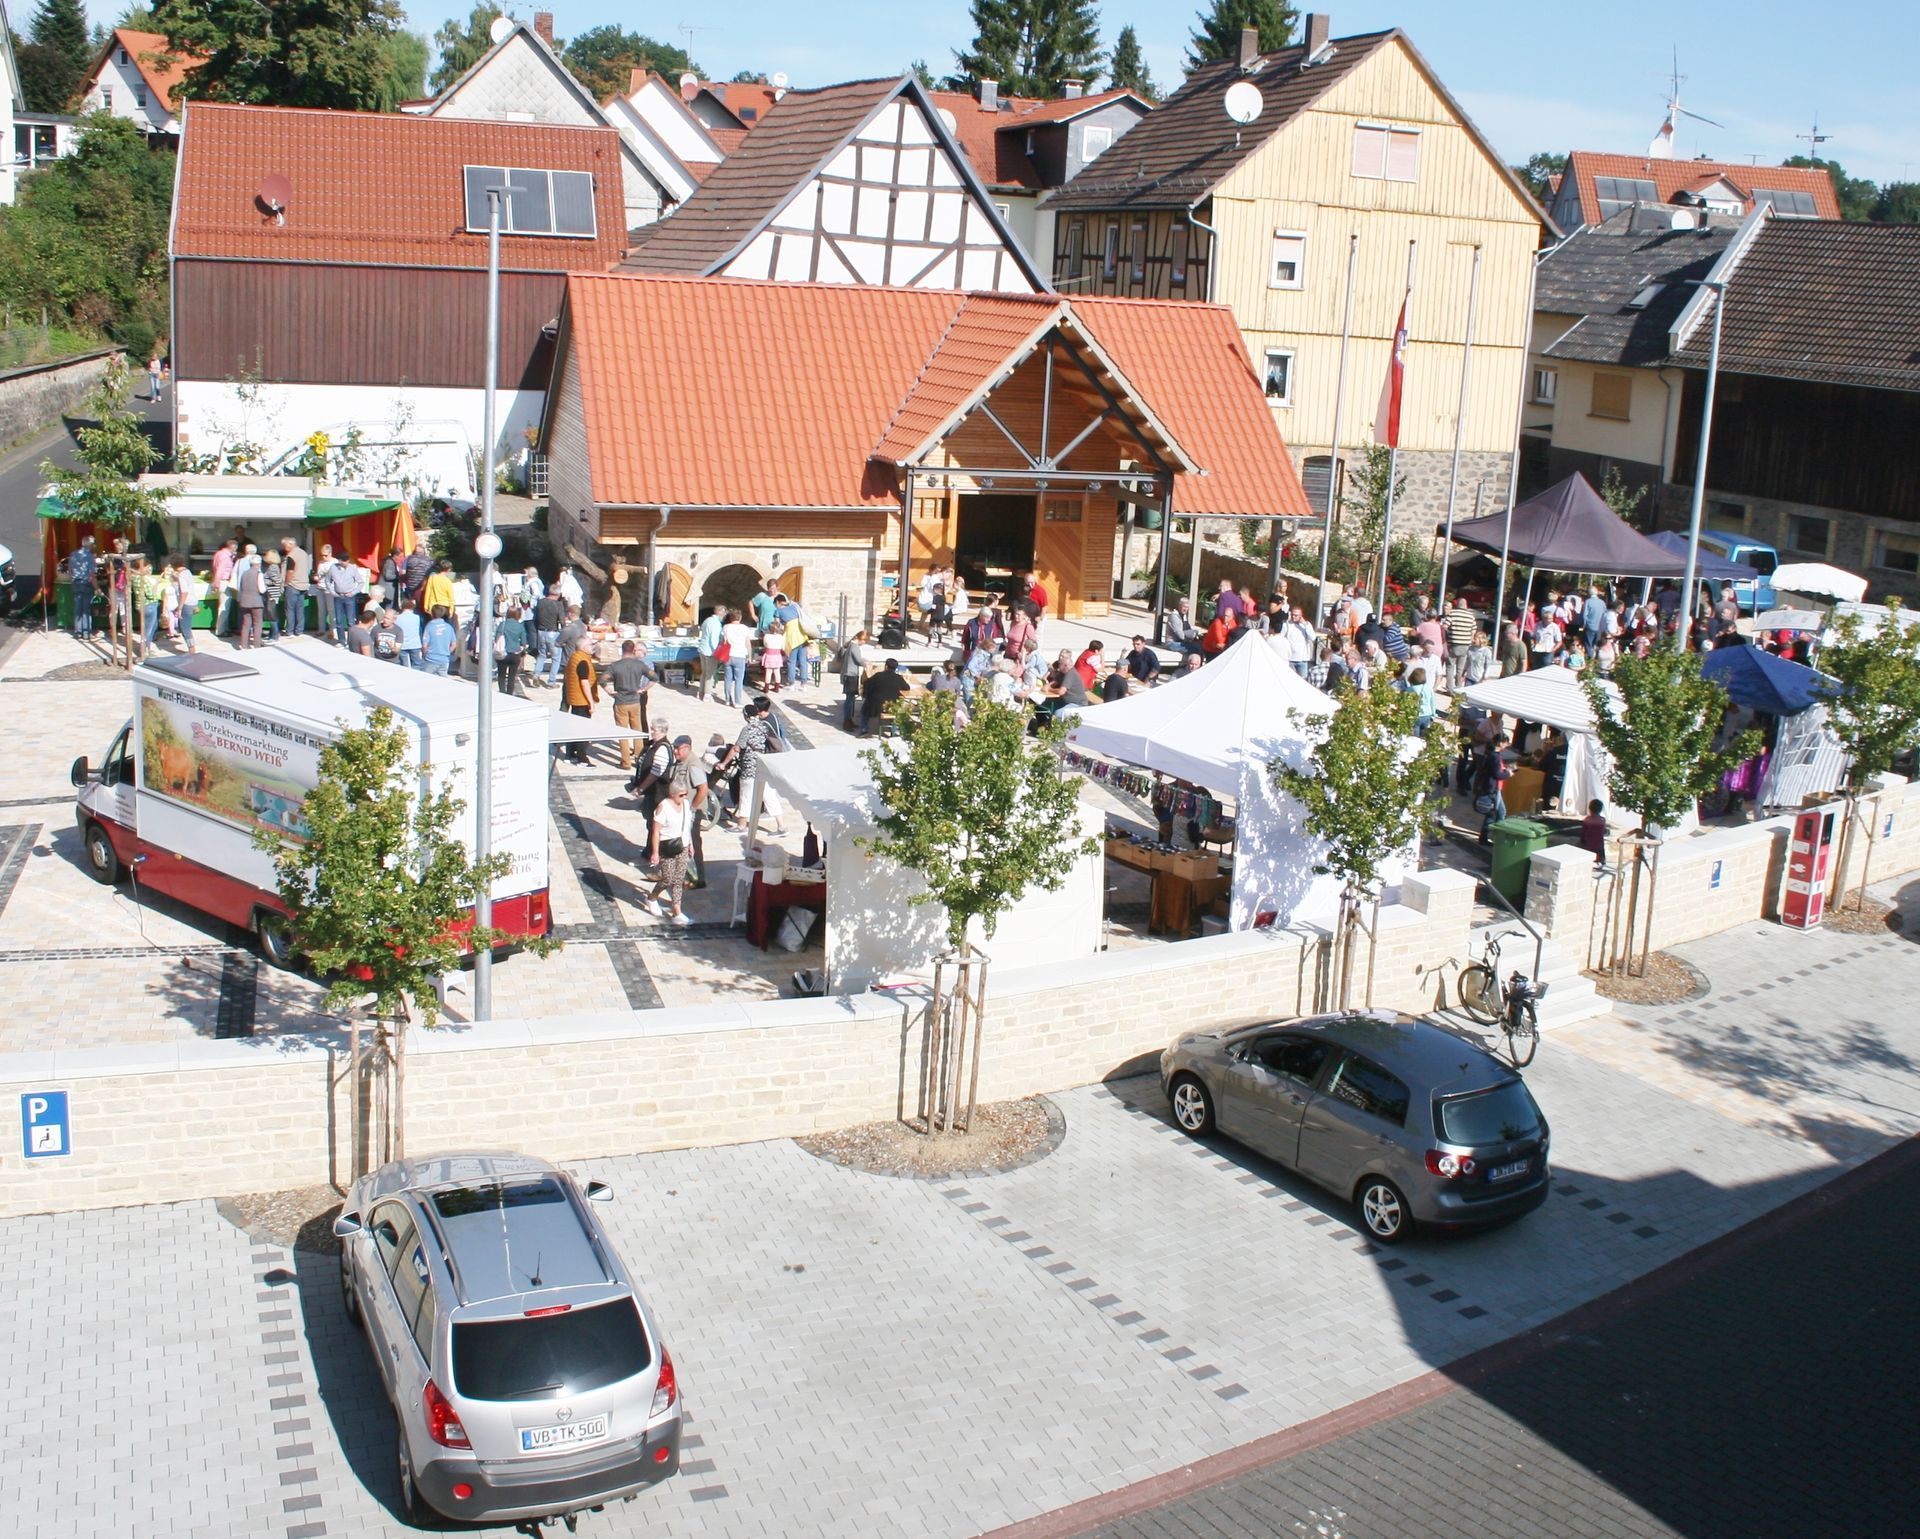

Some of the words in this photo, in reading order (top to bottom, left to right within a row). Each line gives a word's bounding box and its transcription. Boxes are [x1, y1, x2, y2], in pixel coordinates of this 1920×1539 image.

[203, 720, 289, 760] Direktvermarktung
[216, 737, 252, 757] BERND
[294, 733, 307, 746] und
[29, 1097, 48, 1123] P
[533, 1430, 550, 1444] VB
[559, 1426, 576, 1440] TK
[579, 1420, 603, 1436] 500
